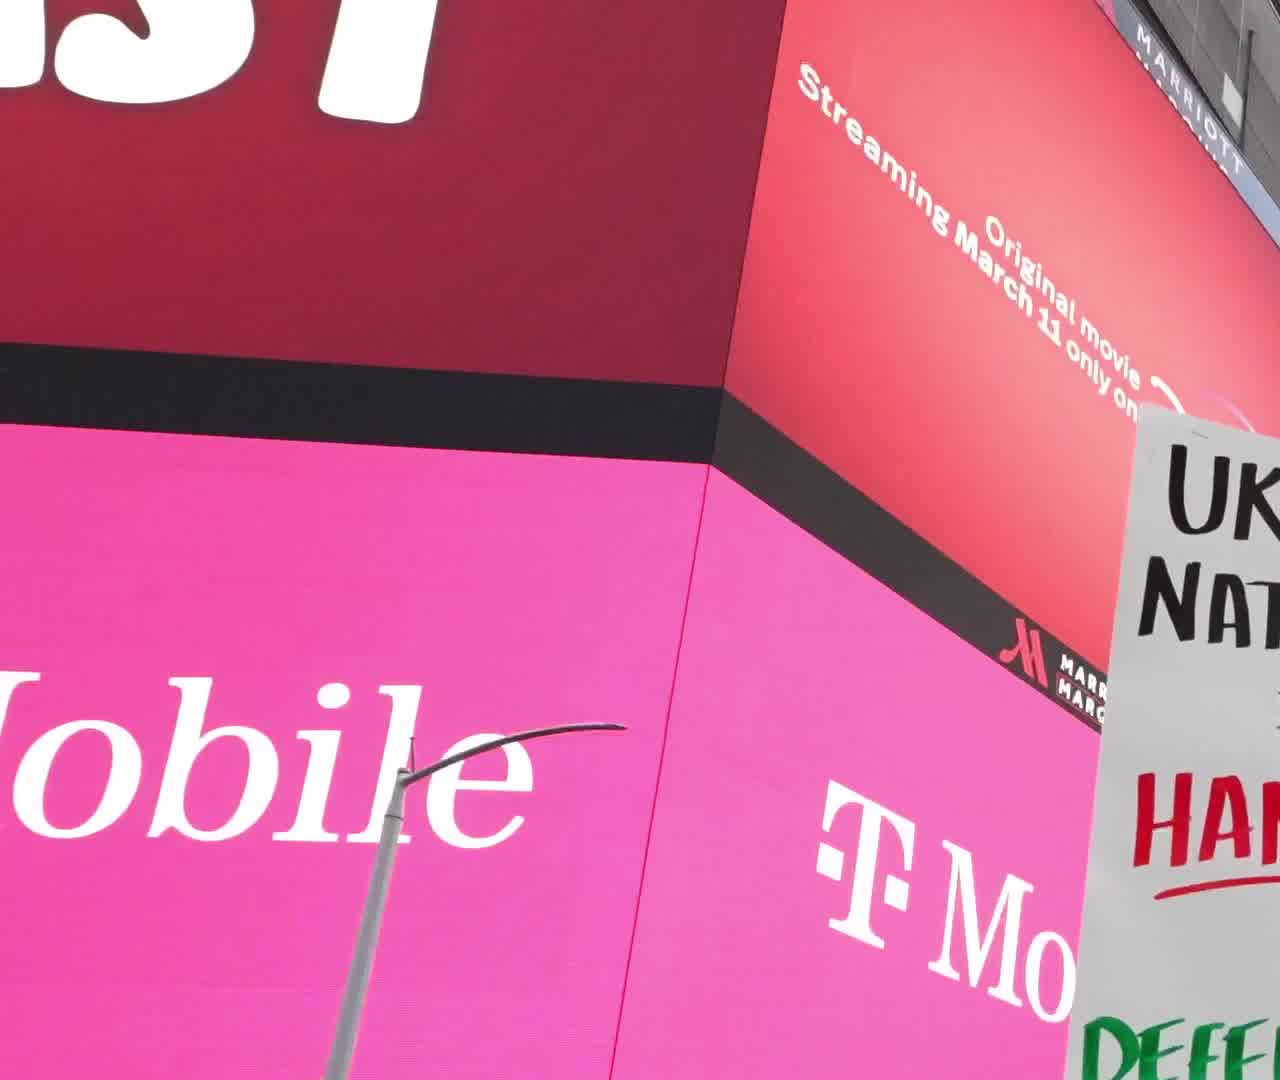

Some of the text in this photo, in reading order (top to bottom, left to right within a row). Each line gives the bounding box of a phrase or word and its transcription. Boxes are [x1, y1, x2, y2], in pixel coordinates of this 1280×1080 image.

[797, 63, 950, 237] Streaming
[954, 220, 1034, 317] March
[1066, 340, 1111, 396] only
[1113, 387, 1138, 423] on
[985, 216, 1141, 391] Original movie
[0, 671, 535, 849] obile
[927, 838, 1077, 1024] Mo
